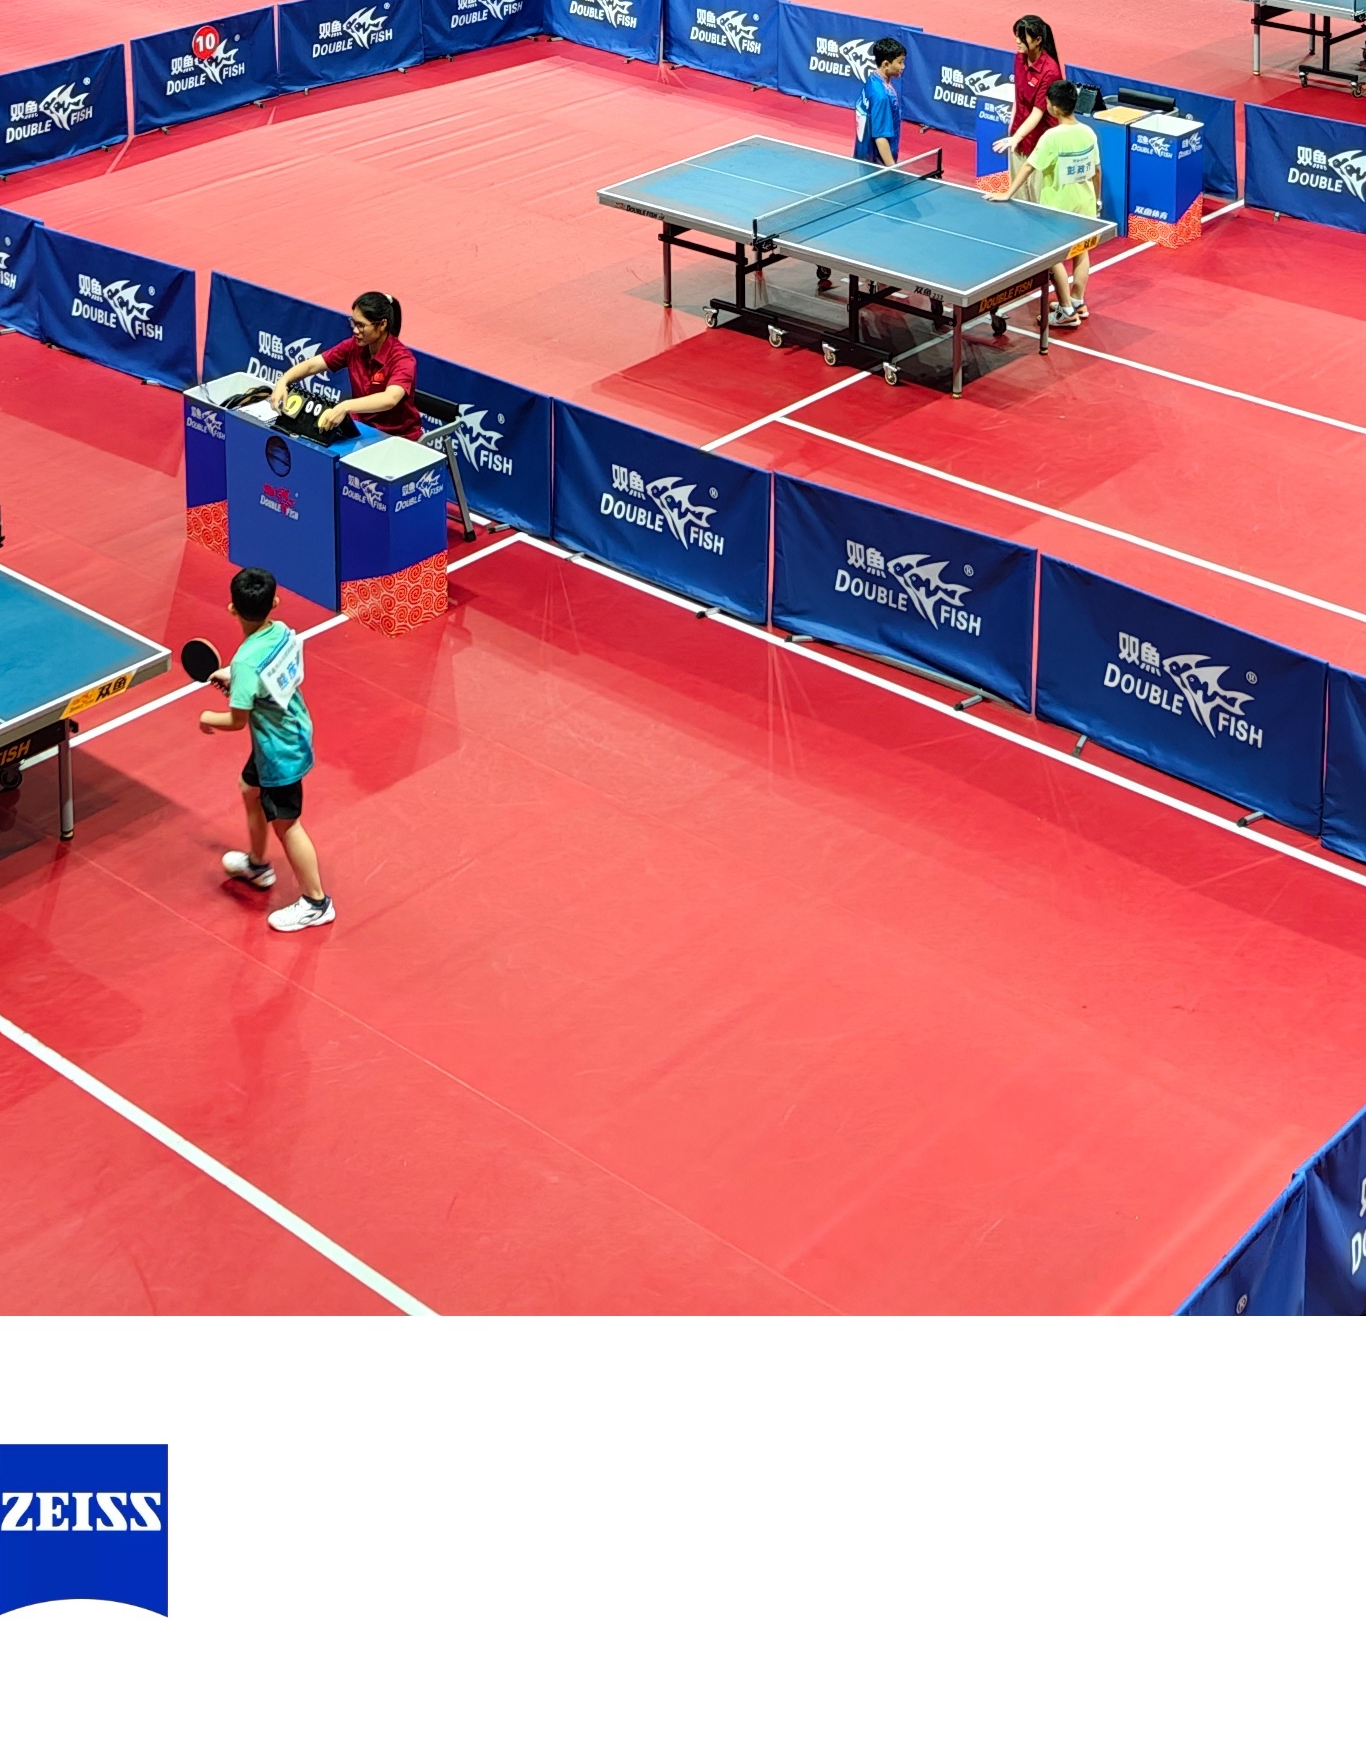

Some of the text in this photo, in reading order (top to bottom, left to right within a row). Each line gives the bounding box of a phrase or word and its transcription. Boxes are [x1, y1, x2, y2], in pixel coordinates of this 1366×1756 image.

[570, 1, 637, 28] DOUBLE FISH
[196, 33, 215, 52] 10
[312, 28, 393, 58] DOUBLE FISH
[690, 26, 761, 54] DOUBLE FISH
[166, 62, 245, 95] DOUBLE FISH
[6, 106, 93, 143] DOUBLE FISH
[1288, 164, 1343, 192] DOUBLE
[626, 204, 646, 215] DOUBLE
[978, 279, 1034, 314] DOUBLE FISH
[71, 294, 163, 341] DOUBLE FISH
[342, 486, 387, 512] DOUBLE FISH
[395, 483, 444, 513] DOUBLE FISH
[600, 489, 724, 555] DOUBLE FISH
[835, 566, 981, 636] DOUBLE FISH
[1104, 663, 1263, 748] DOUBLE FISH
